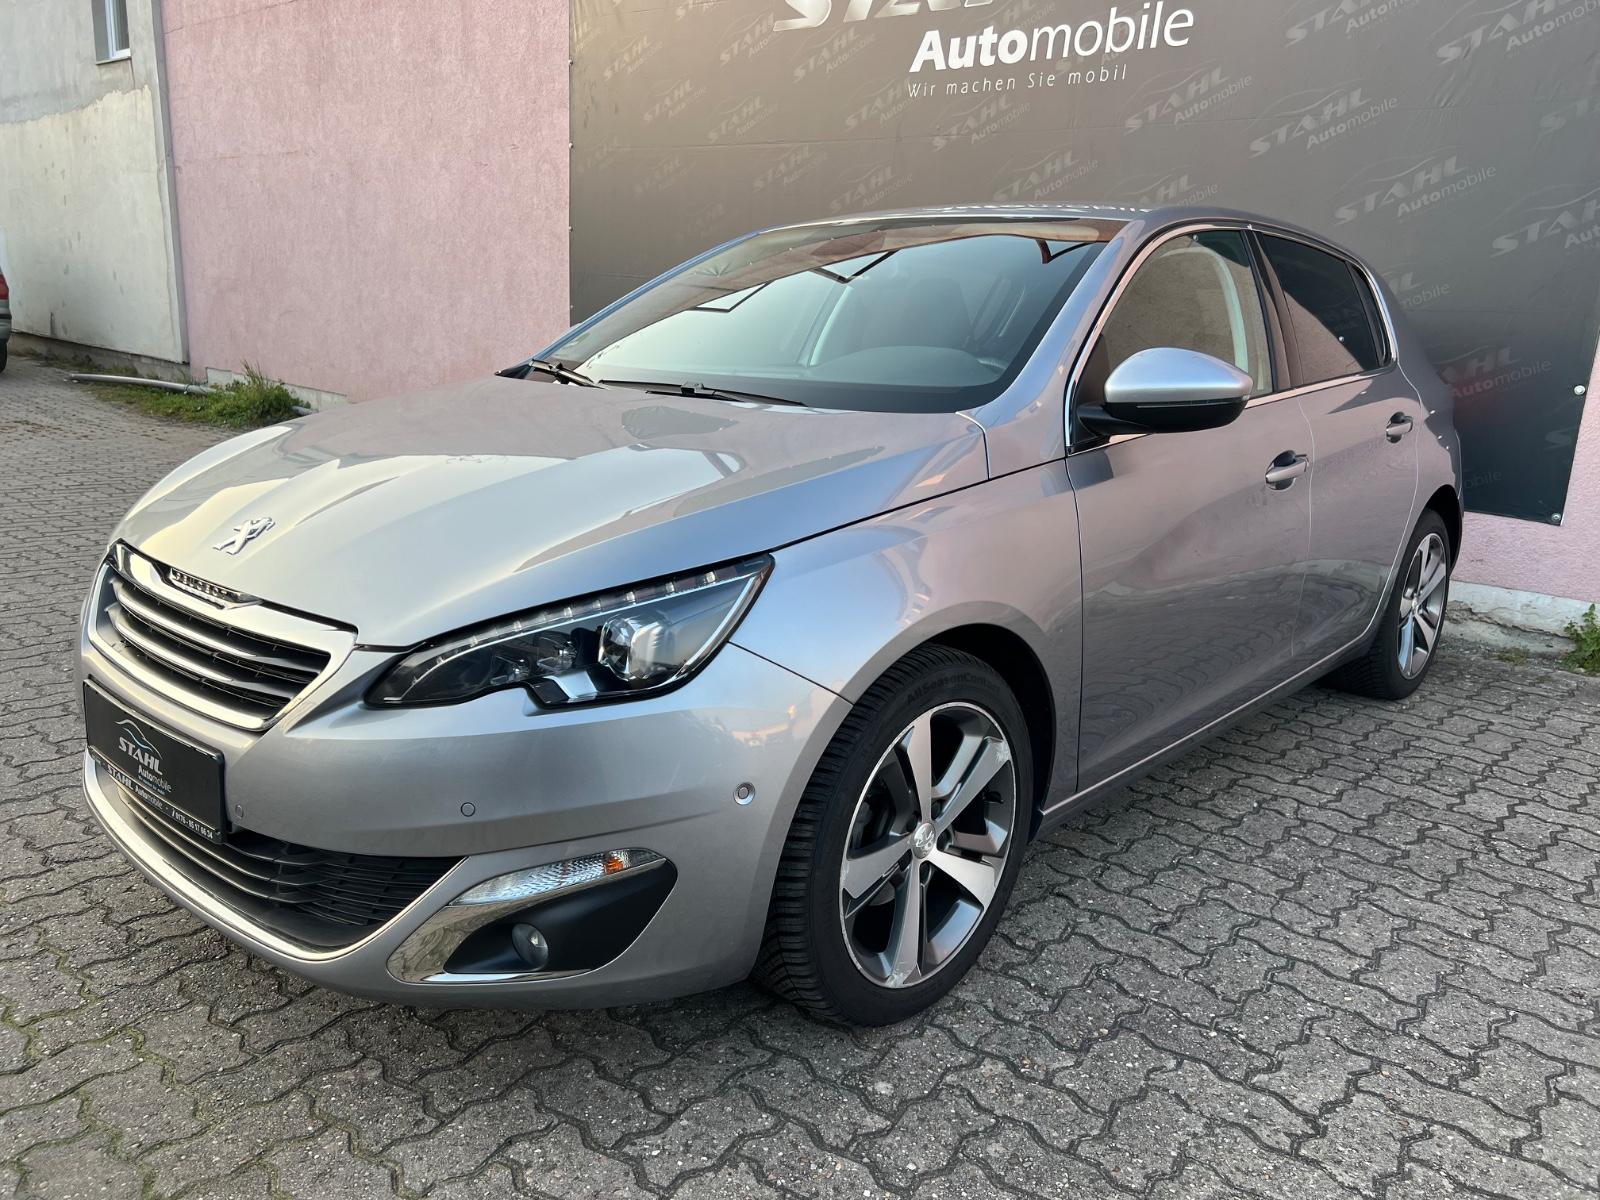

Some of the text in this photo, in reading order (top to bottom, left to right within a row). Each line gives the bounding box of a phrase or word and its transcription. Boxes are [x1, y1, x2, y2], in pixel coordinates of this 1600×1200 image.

[909, 1, 1193, 72] Automobile
[1435, 0, 1572, 65] STAH
[908, 64, 1127, 98] Wir machen Sie mobil
[1123, 64, 1230, 136] STAHL
[1249, 88, 1372, 159] STAHL
[1306, 96, 1398, 149] Automobile
[1333, 155, 1470, 227] STAHL
[1396, 164, 1496, 217] Automobile
[107, 764, 134, 790] STAHL
[118, 736, 163, 776] STAHL
[138, 764, 172, 793] Automobile
